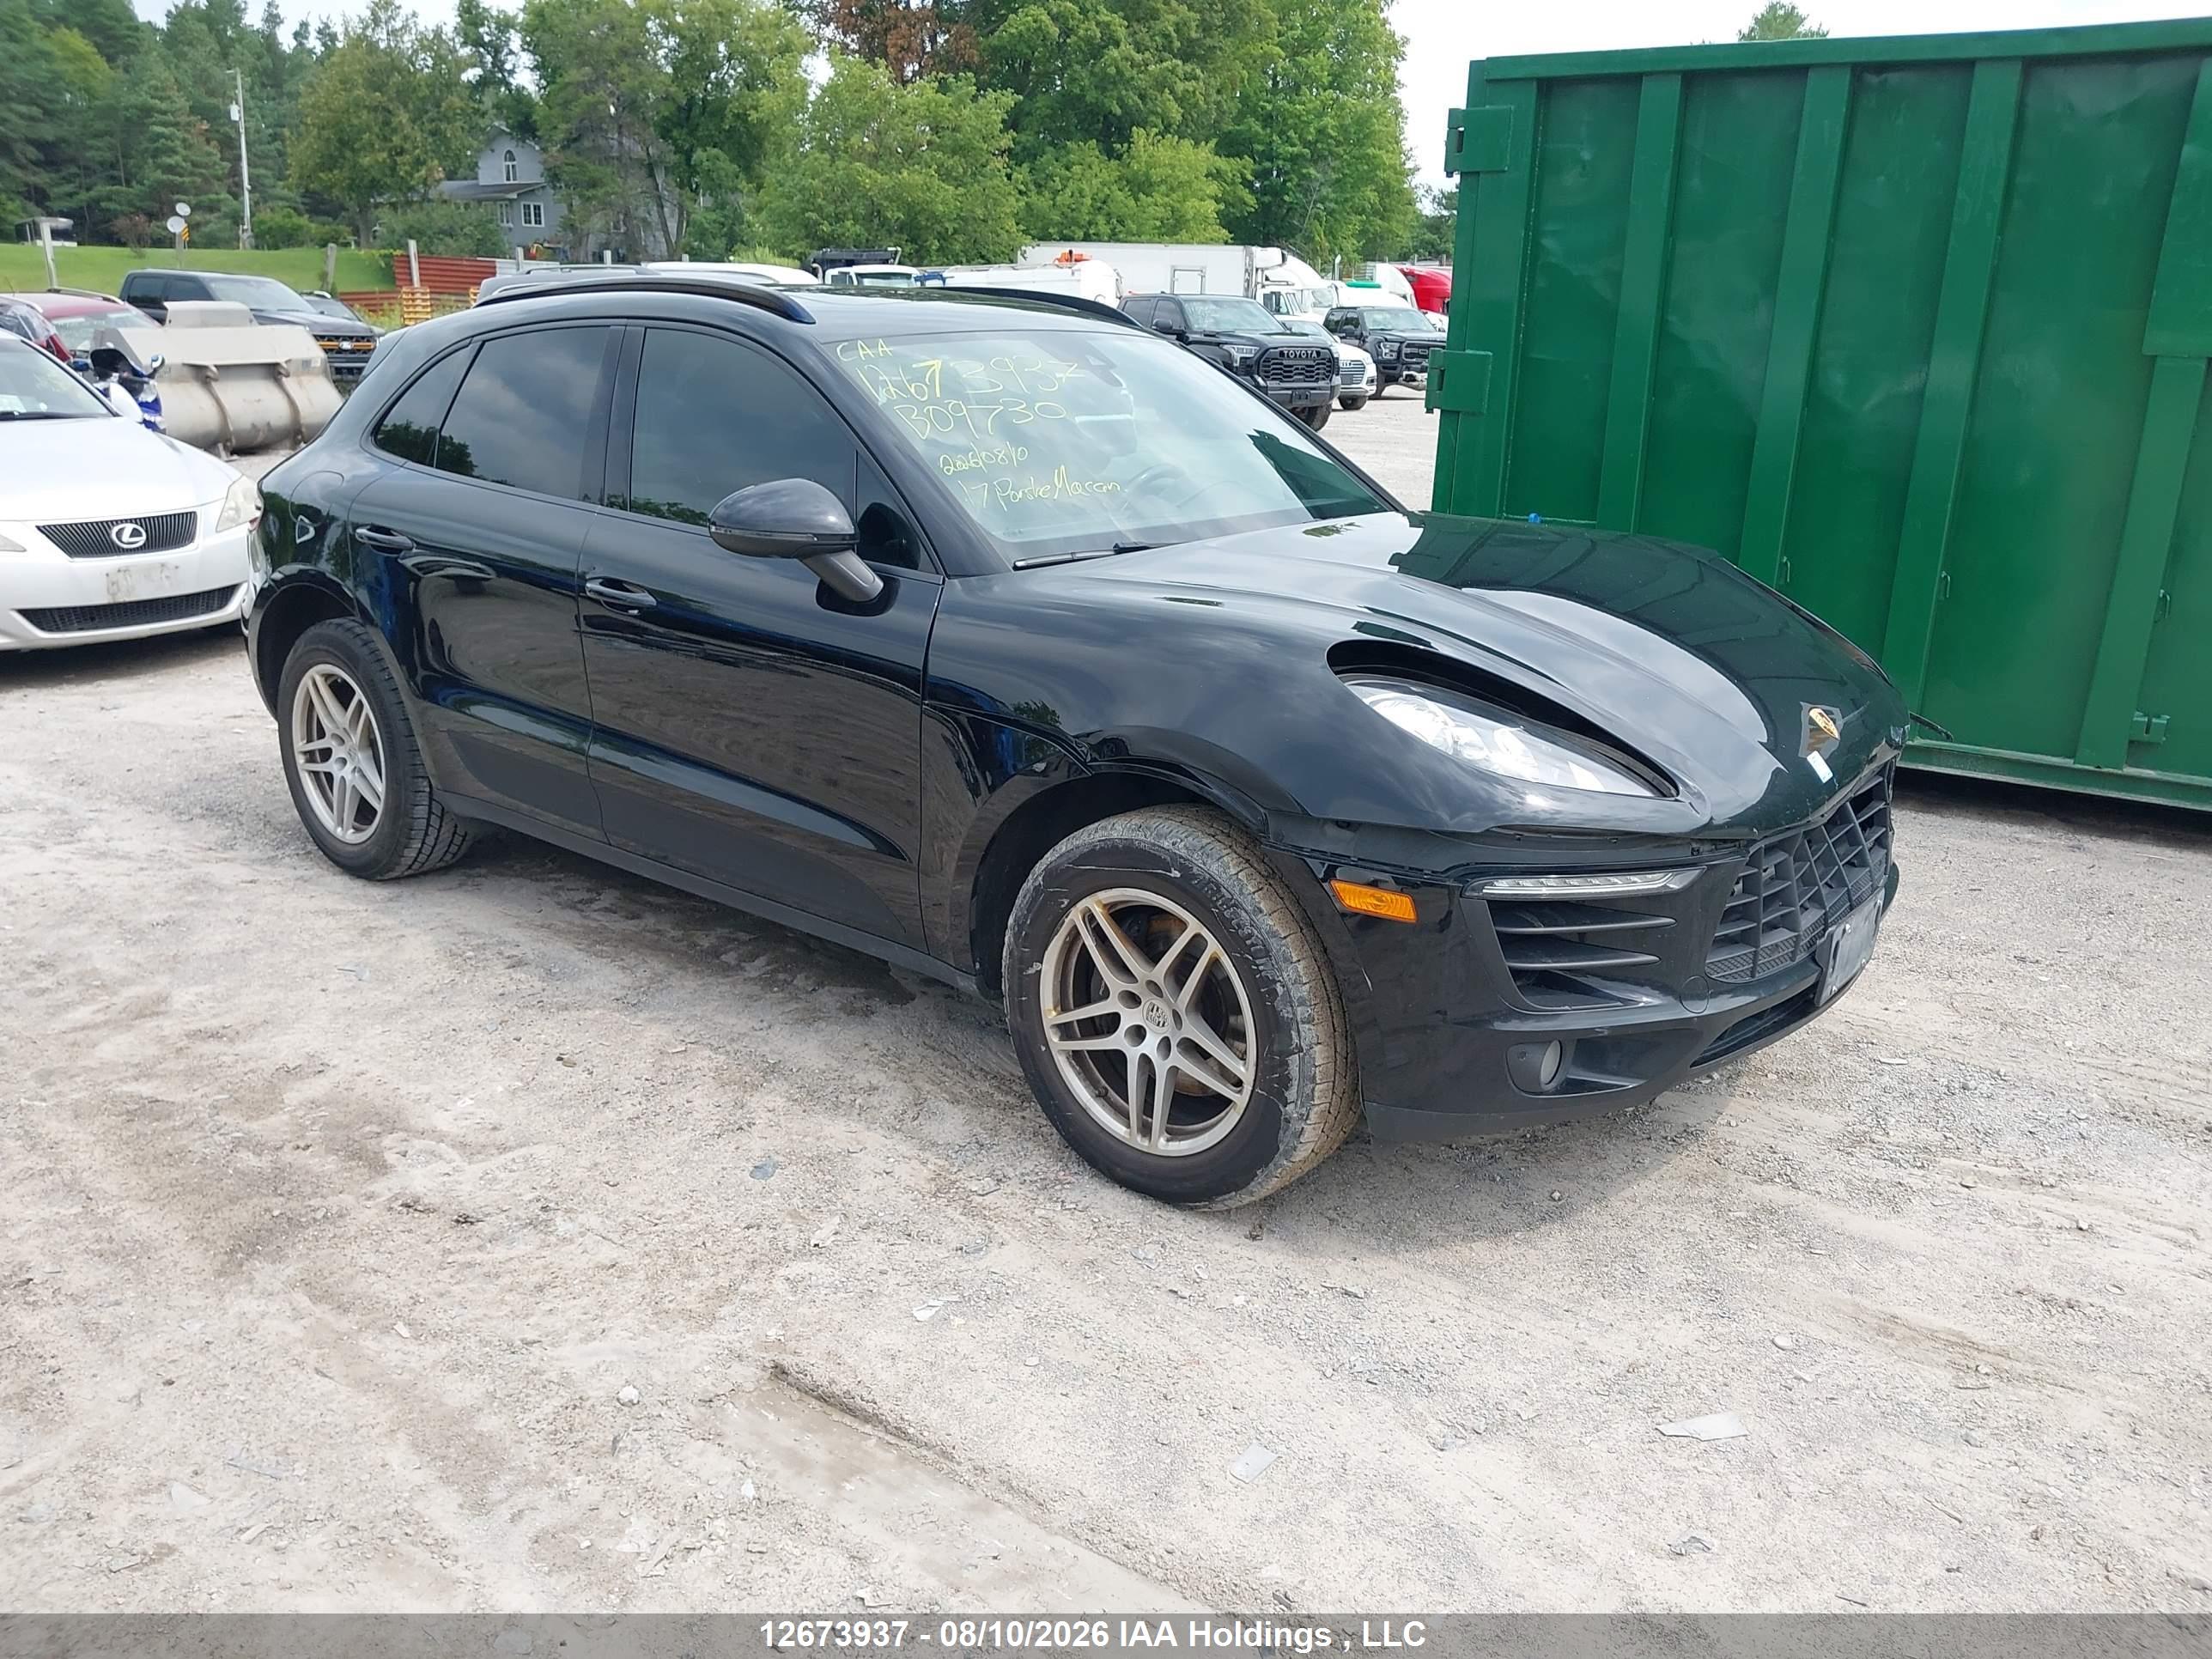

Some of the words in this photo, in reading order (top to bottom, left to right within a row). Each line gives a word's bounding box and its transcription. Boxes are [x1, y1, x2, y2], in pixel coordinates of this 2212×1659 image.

[836, 338, 894, 362] CAA
[1282, 349, 1318, 359] TOYOTA
[893, 397, 1067, 441] B09730
